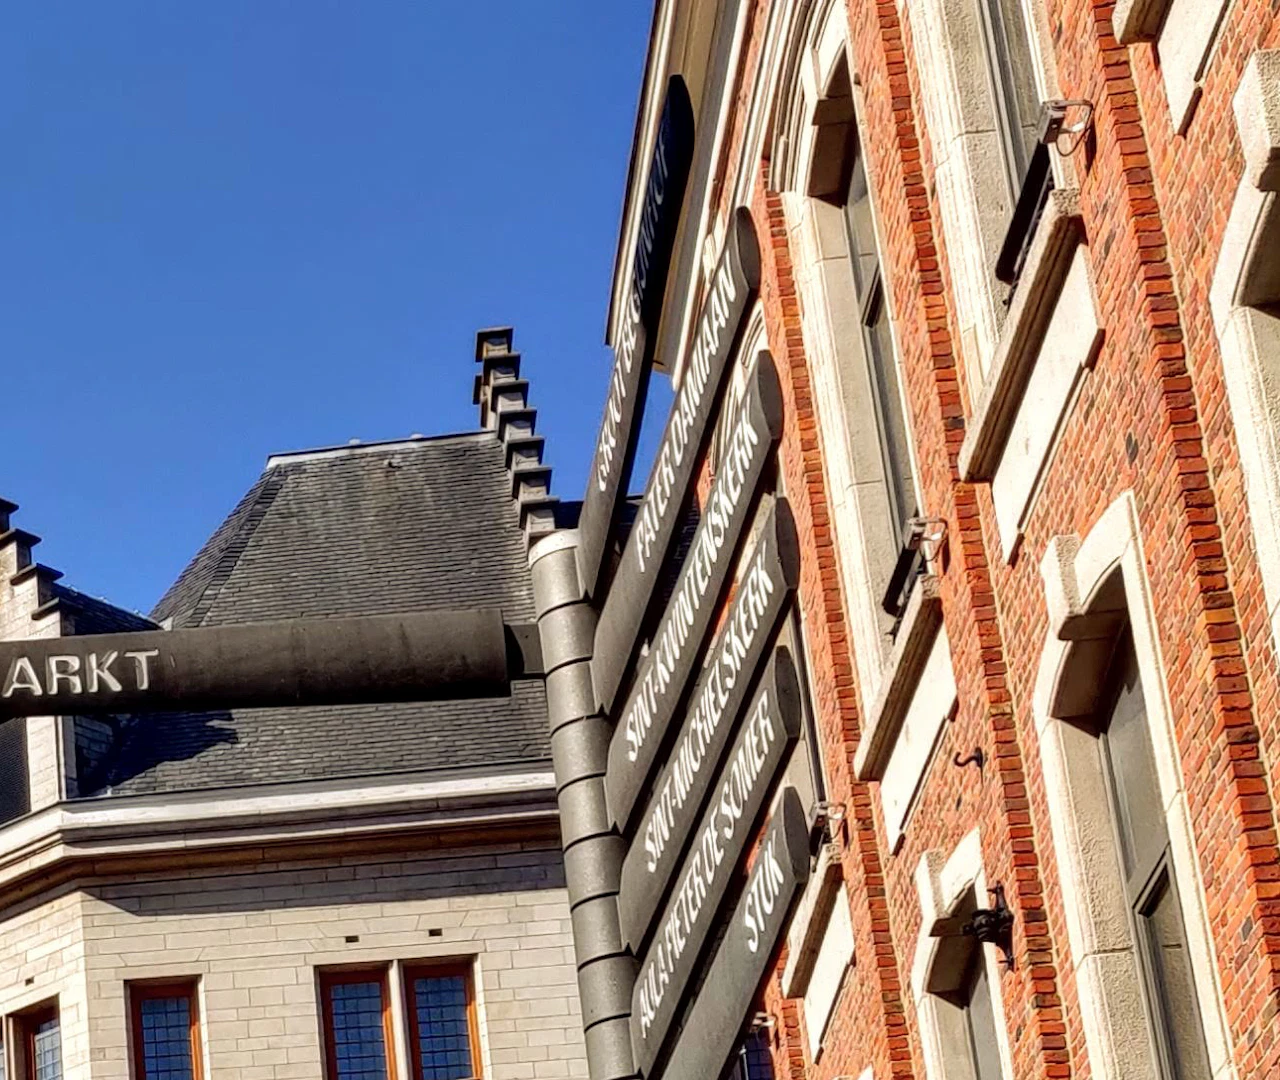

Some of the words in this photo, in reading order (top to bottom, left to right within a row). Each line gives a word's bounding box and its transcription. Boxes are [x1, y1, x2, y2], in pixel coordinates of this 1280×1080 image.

[627, 392, 759, 763] SINT-KWINTENSKERK
[636, 440, 676, 573] PATER
[670, 248, 737, 467] DAMIAAN
[640, 942, 670, 1039] AULA
[665, 850, 707, 974] PIETER
[702, 806, 725, 885] DE
[721, 689, 775, 840] SOMER
[646, 539, 774, 873] SINT-MICHIELSKERK
[745, 829, 784, 953] STUK
